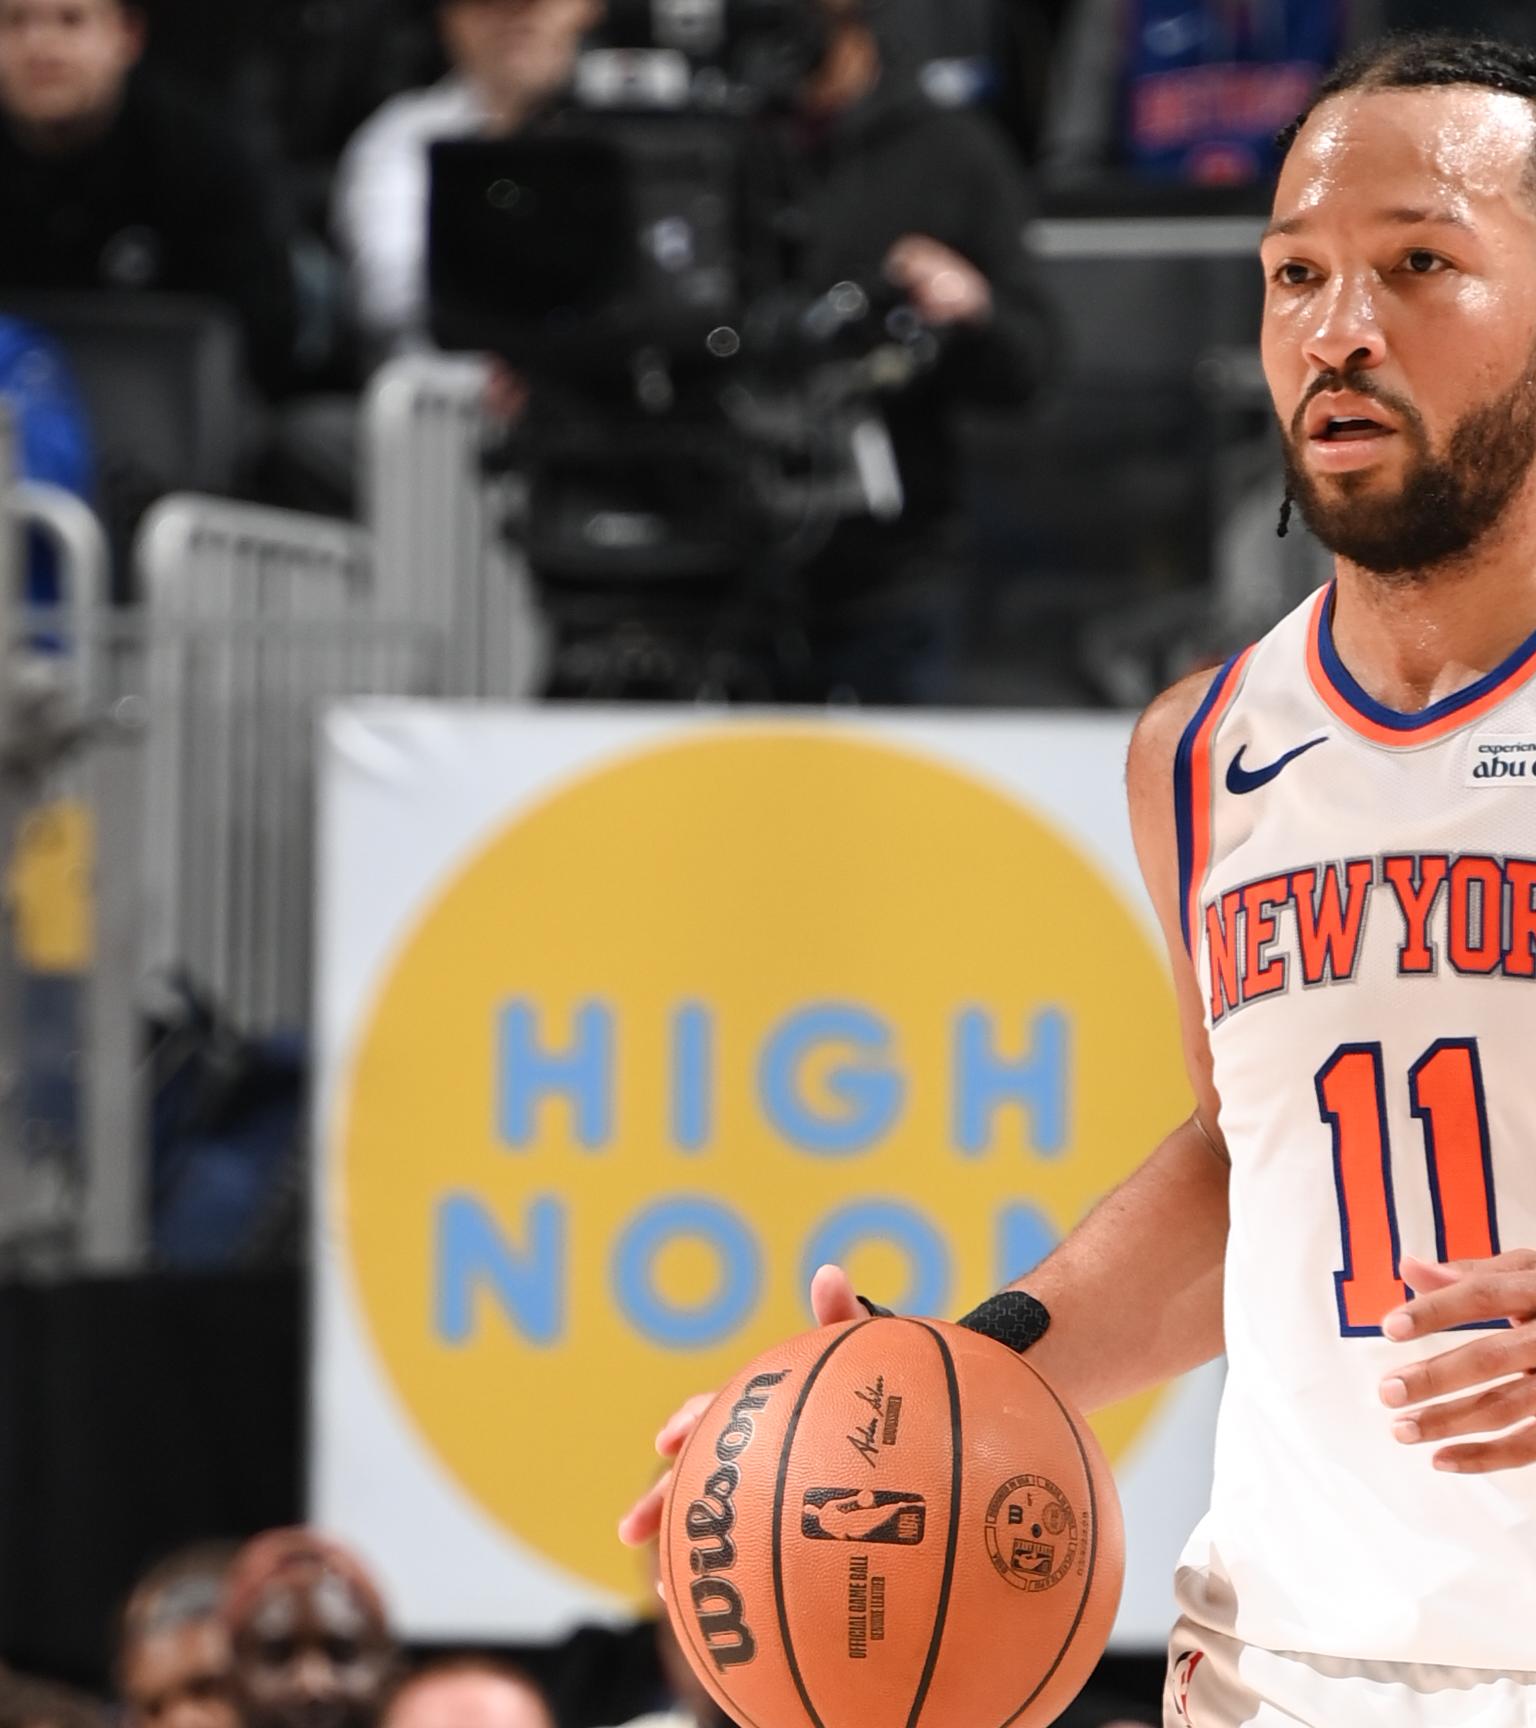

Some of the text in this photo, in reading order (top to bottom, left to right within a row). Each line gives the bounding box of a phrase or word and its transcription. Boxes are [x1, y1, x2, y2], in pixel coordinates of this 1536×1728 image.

[1472, 757, 1526, 779] abu
[1204, 857, 1375, 1030] NEW
[497, 997, 1074, 1156] HIGH
[1313, 1036, 1513, 1338] 11
[848, 1555, 868, 1659] OFFICIAL GAME BALL
[870, 1576, 885, 1608] LEATHER
